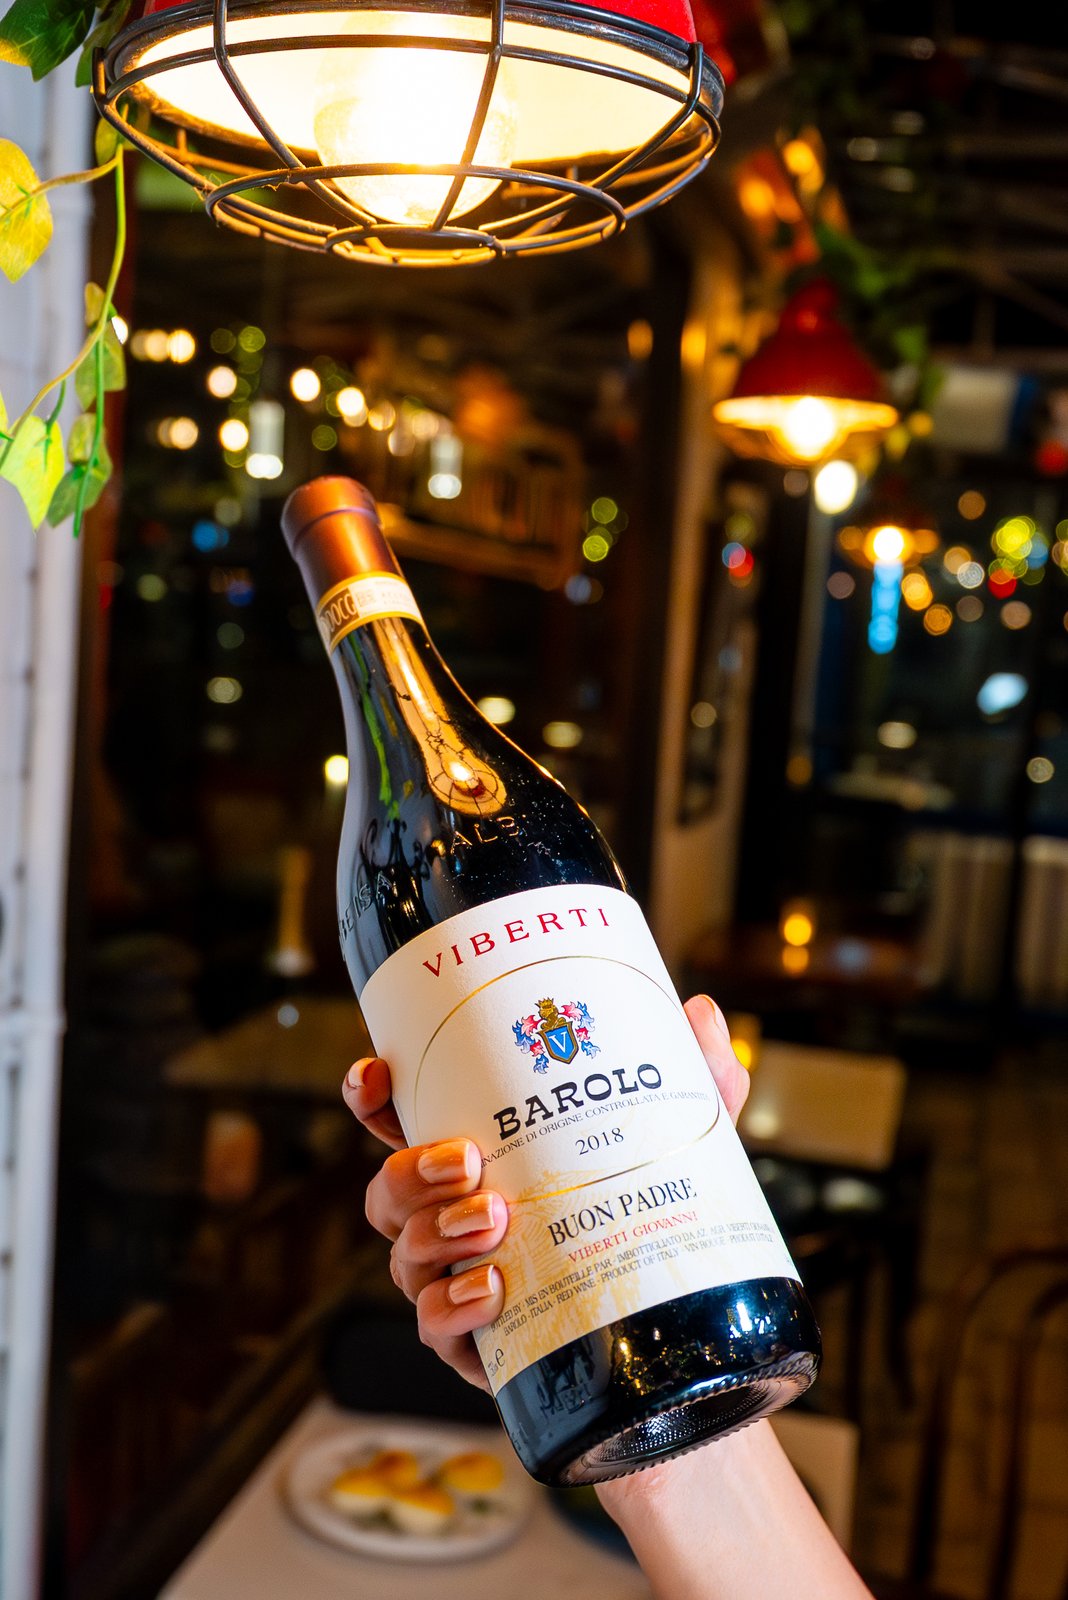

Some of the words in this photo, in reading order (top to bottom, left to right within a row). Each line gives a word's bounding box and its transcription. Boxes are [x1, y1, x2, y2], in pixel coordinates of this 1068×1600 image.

[422, 907, 610, 978] VIBERTI
[548, 1031, 567, 1053] V
[481, 1137, 525, 1168] INAZIONE
[525, 1131, 538, 1143] DI
[538, 1112, 583, 1136] ORIGINE
[585, 1093, 661, 1119] CONTROLLATA
[661, 1092, 669, 1101] E
[493, 1063, 662, 1140] BAROLO
[575, 1127, 624, 1155] 2018
[547, 1199, 614, 1247] BUON
[618, 1177, 697, 1217] PADRE
[568, 1230, 629, 1263] VIBERTI
[632, 1210, 698, 1238] GIOVANNI
[503, 1314, 527, 1337] BAROLO
[530, 1301, 554, 1319] ITALIA
[556, 1290, 574, 1305] RED
[574, 1278, 597, 1294] WINE
[600, 1259, 642, 1283] PRODUCT
[643, 1253, 656, 1266] OF
[656, 1248, 679, 1262] ITALY
[684, 1241, 700, 1253] VIN
[513, 1303, 522, 1316] BY
[525, 1293, 539, 1308] MIS
[538, 1286, 550, 1300] EN
[549, 1265, 592, 1294] BOUTEILLE
[593, 1258, 612, 1273] PAR
[616, 1234, 682, 1263] IMBOTTIGLIATO
[682, 1230, 696, 1241] DA
